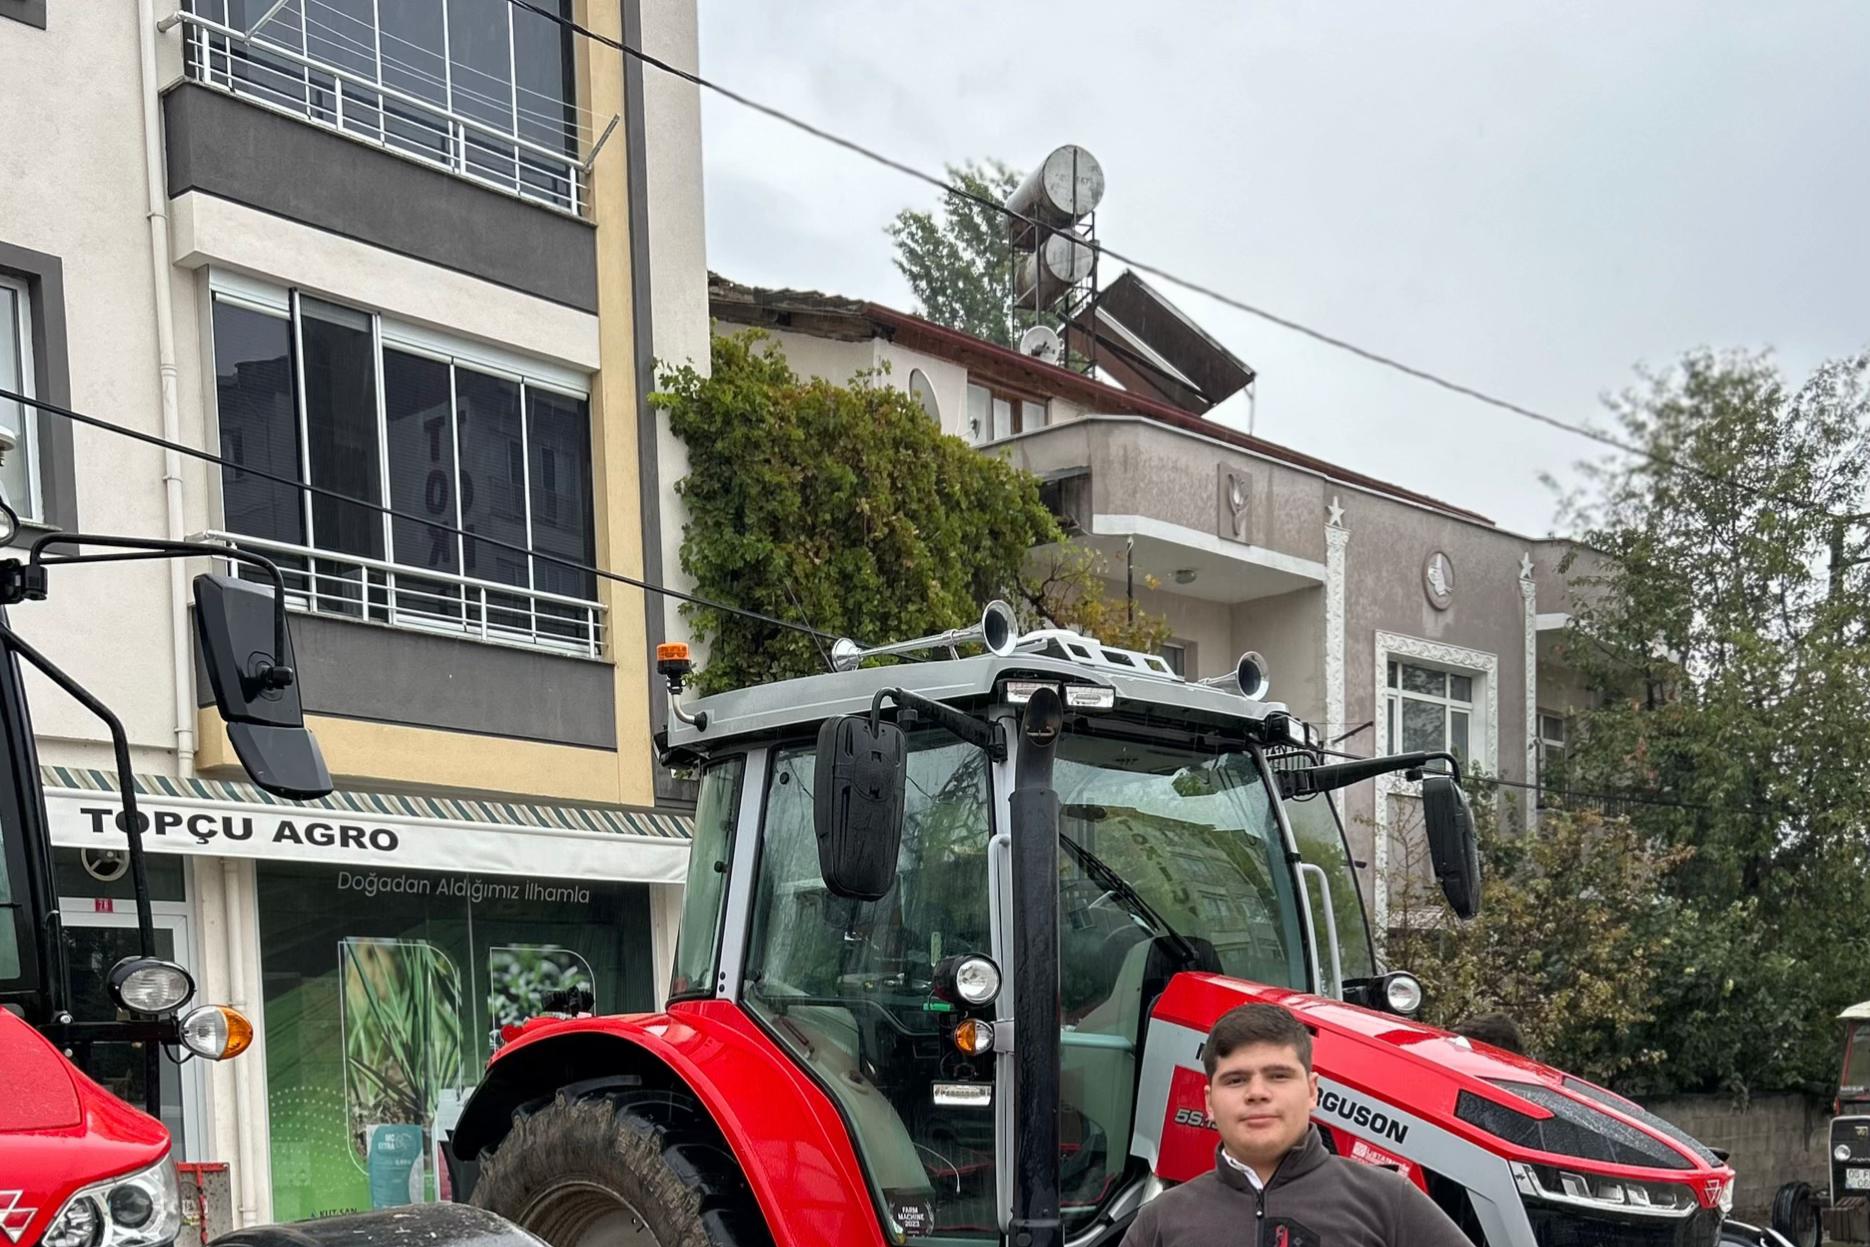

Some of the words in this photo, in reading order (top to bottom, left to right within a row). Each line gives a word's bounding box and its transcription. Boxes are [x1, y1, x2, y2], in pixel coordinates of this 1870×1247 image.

[80, 807, 253, 845] TOPÇU
[272, 820, 399, 852] AGRO
[337, 871, 431, 897] Doğadan
[436, 877, 520, 903] Aldığımız
[525, 880, 590, 904] İlhamla
[1316, 1086, 1409, 1145] GUSON
[897, 1212, 925, 1221] MACHINE
[904, 1220, 921, 1228] 2023
